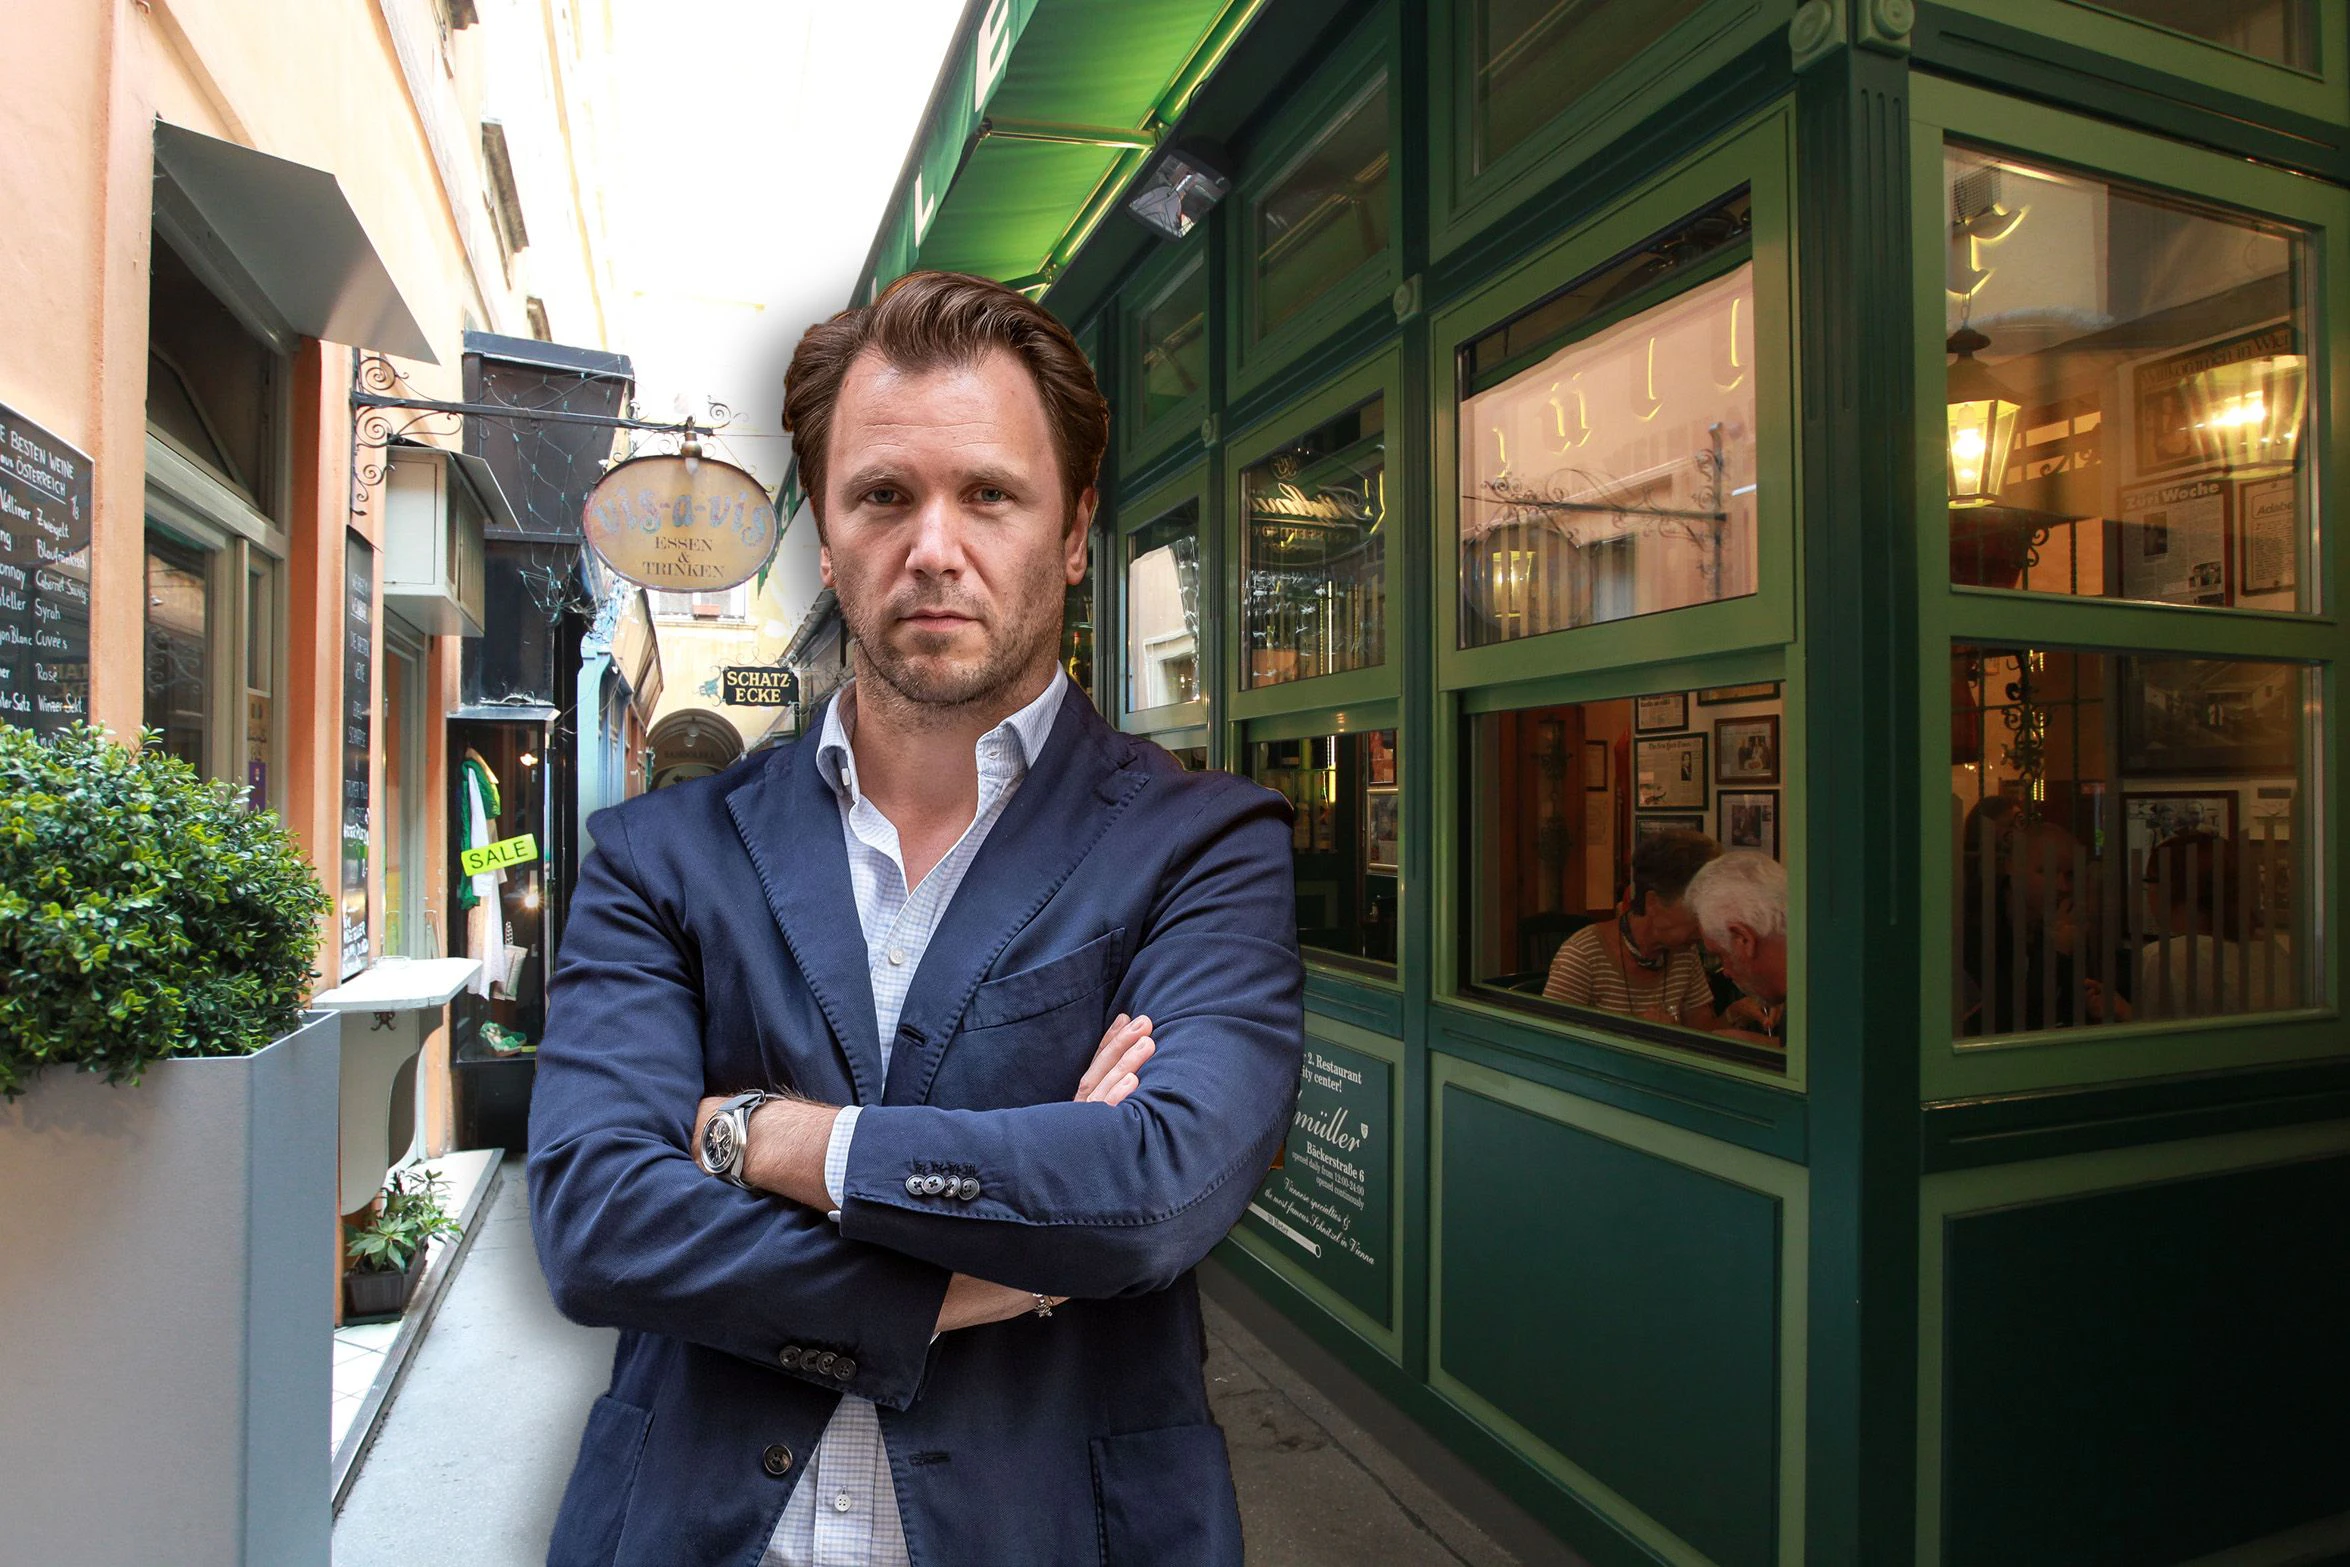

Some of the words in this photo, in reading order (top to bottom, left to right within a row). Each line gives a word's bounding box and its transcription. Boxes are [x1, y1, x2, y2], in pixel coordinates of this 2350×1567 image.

[11, 430, 46, 465] BESTEN
[49, 451, 74, 480] WEINE
[16, 455, 66, 497] ÖSTERREICH
[2162, 481, 2220, 505] Woche
[36, 507, 70, 541] Zweigelt
[655, 535, 713, 552] ESSEN
[642, 561, 725, 579] TRINKEN
[677, 551, 691, 563] &
[0, 586, 26, 611] teller
[35, 597, 61, 623] Syrah
[9, 624, 33, 646] Blanc
[12, 692, 31, 713] Satz
[735, 686, 781, 703] ECKE
[469, 840, 529, 872] SALE
[1301, 1065, 1313, 1083] ity
[1313, 1073, 1343, 1093] center!
[1316, 1054, 1362, 1085] Restaurant
[1294, 1106, 1360, 1152] müller
[1306, 1141, 1358, 1179] Bäckerstraße
[1359, 1169, 1365, 1183] 6
[1308, 1159, 1321, 1175] daily
[1321, 1164, 1333, 1180] from
[1264, 1187, 1274, 1200] the
[1273, 1194, 1288, 1209] most
[1285, 1201, 1311, 1224] famous
[1309, 1212, 1342, 1243] Schnitzel
[1340, 1237, 1348, 1248] in
[1350, 1237, 1376, 1265] Vienna
